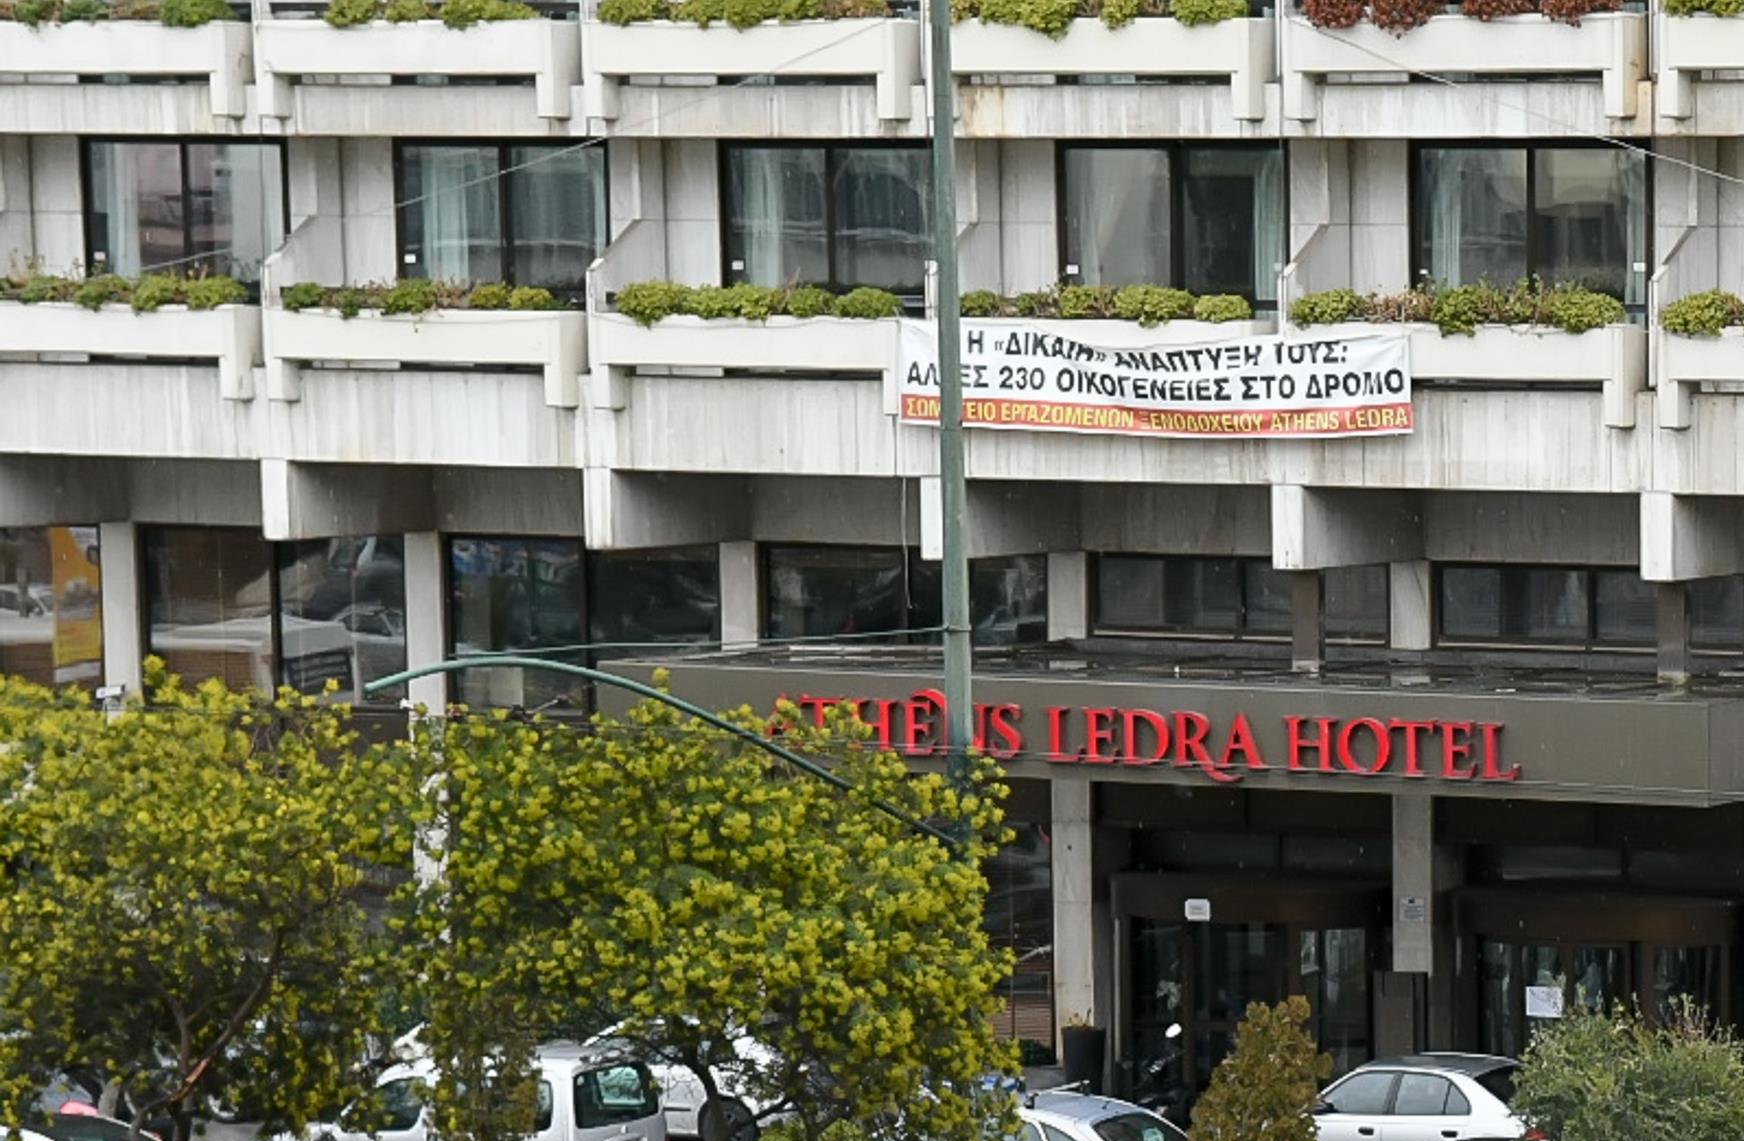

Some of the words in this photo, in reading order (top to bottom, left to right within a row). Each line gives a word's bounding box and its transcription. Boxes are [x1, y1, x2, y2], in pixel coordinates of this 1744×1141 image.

[968, 330, 984, 354] Η
[1114, 345, 1262, 372] ΑΝΑΠΤΥΞΗ
[907, 360, 990, 389] ΑΛΕΣ
[999, 366, 1046, 391] 230
[1056, 368, 1232, 402] ΟΙΚΟΓΕΝΕΙΕΣ
[1240, 373, 1296, 400] ΣΤΟ
[1305, 367, 1404, 399] ΔΡΟΜΟ
[1001, 401, 1135, 426] ΕΡΓΑΖΟΜΕΝΩΝ
[1139, 410, 1263, 432] ΞΕΝΟΔΟΧΕΙΟΥ
[1270, 411, 1340, 432] ATHENS
[1346, 407, 1409, 429] LEDRA
[1046, 706, 1269, 782] LEDRA
[1283, 715, 1520, 781] HOTEL
